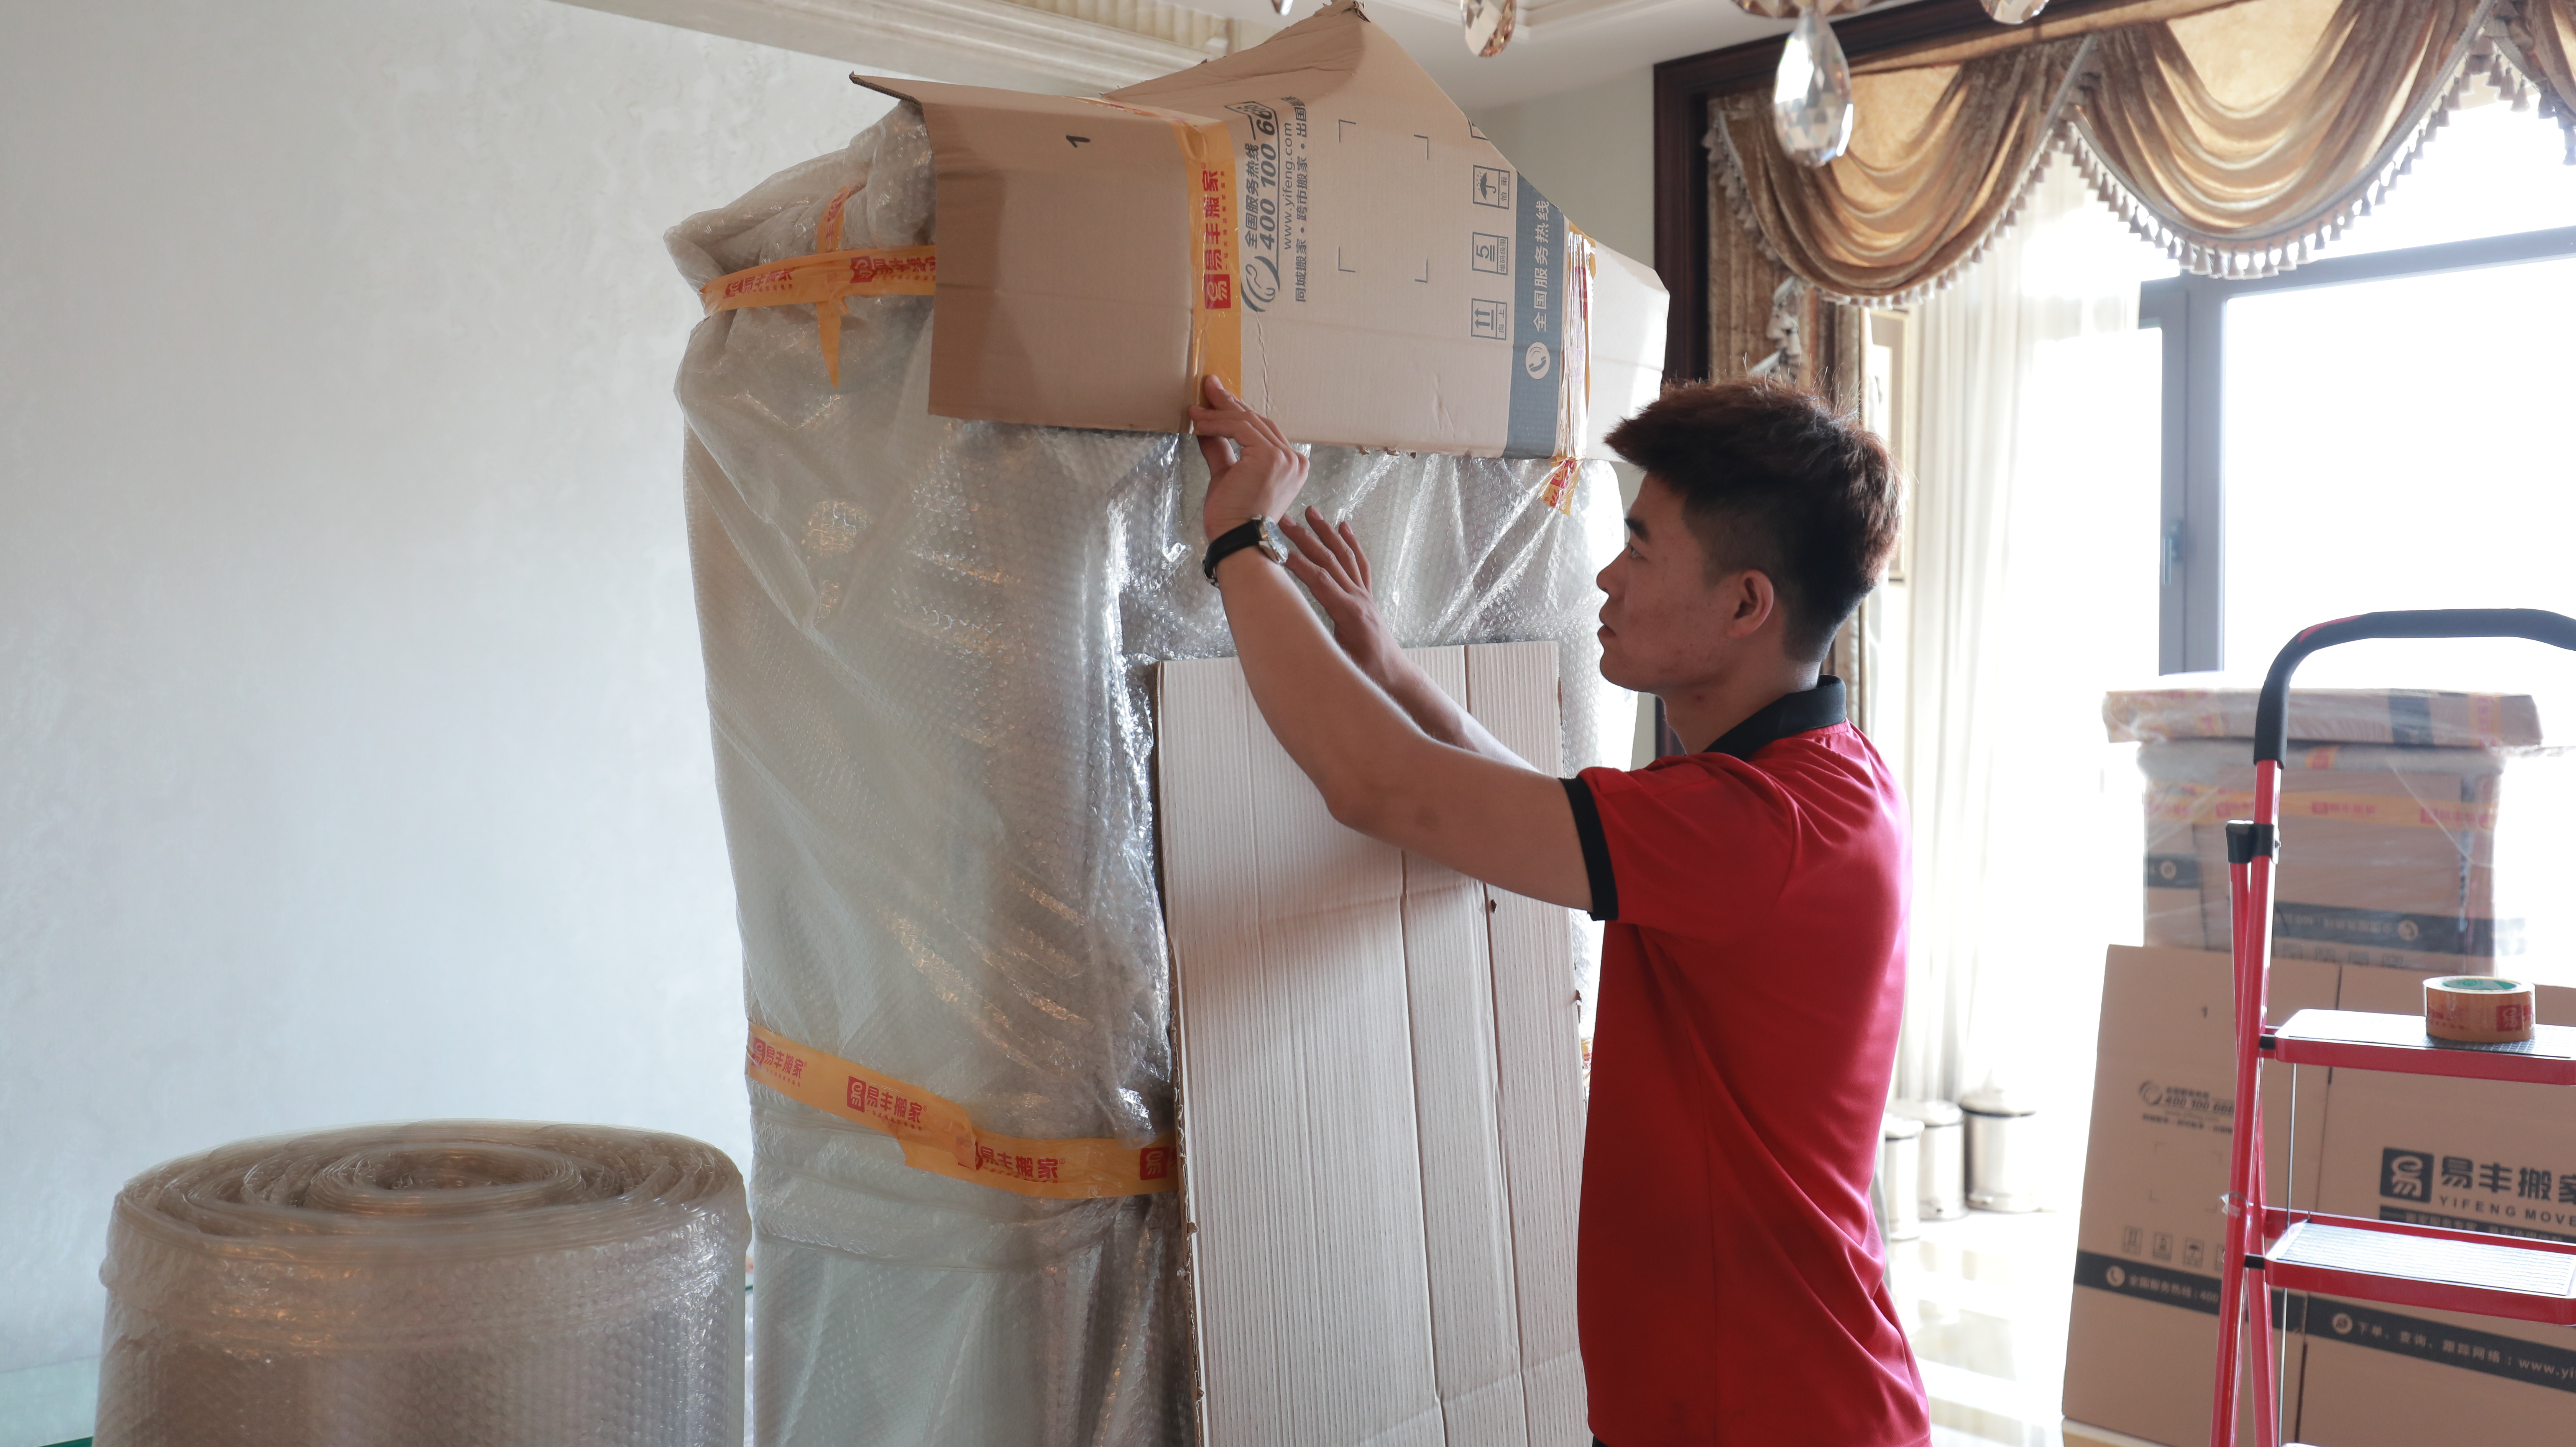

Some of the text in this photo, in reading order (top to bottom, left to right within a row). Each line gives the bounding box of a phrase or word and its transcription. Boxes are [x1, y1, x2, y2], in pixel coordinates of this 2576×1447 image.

[1260, 143, 1276, 187] 100
[1244, 143, 1259, 249] 全国服务热线
[1282, 122, 1295, 249] www.yifeng.com
[1500, 176, 1508, 202] 怕雨
[1259, 199, 1275, 250] 400
[1476, 245, 1490, 259] 5
[1533, 200, 1550, 332] 全国服务热线
[1498, 308, 1505, 333] 向上
[2440, 1194, 2516, 1217] YIFENG
[2518, 1358, 2576, 1380] www.yi
